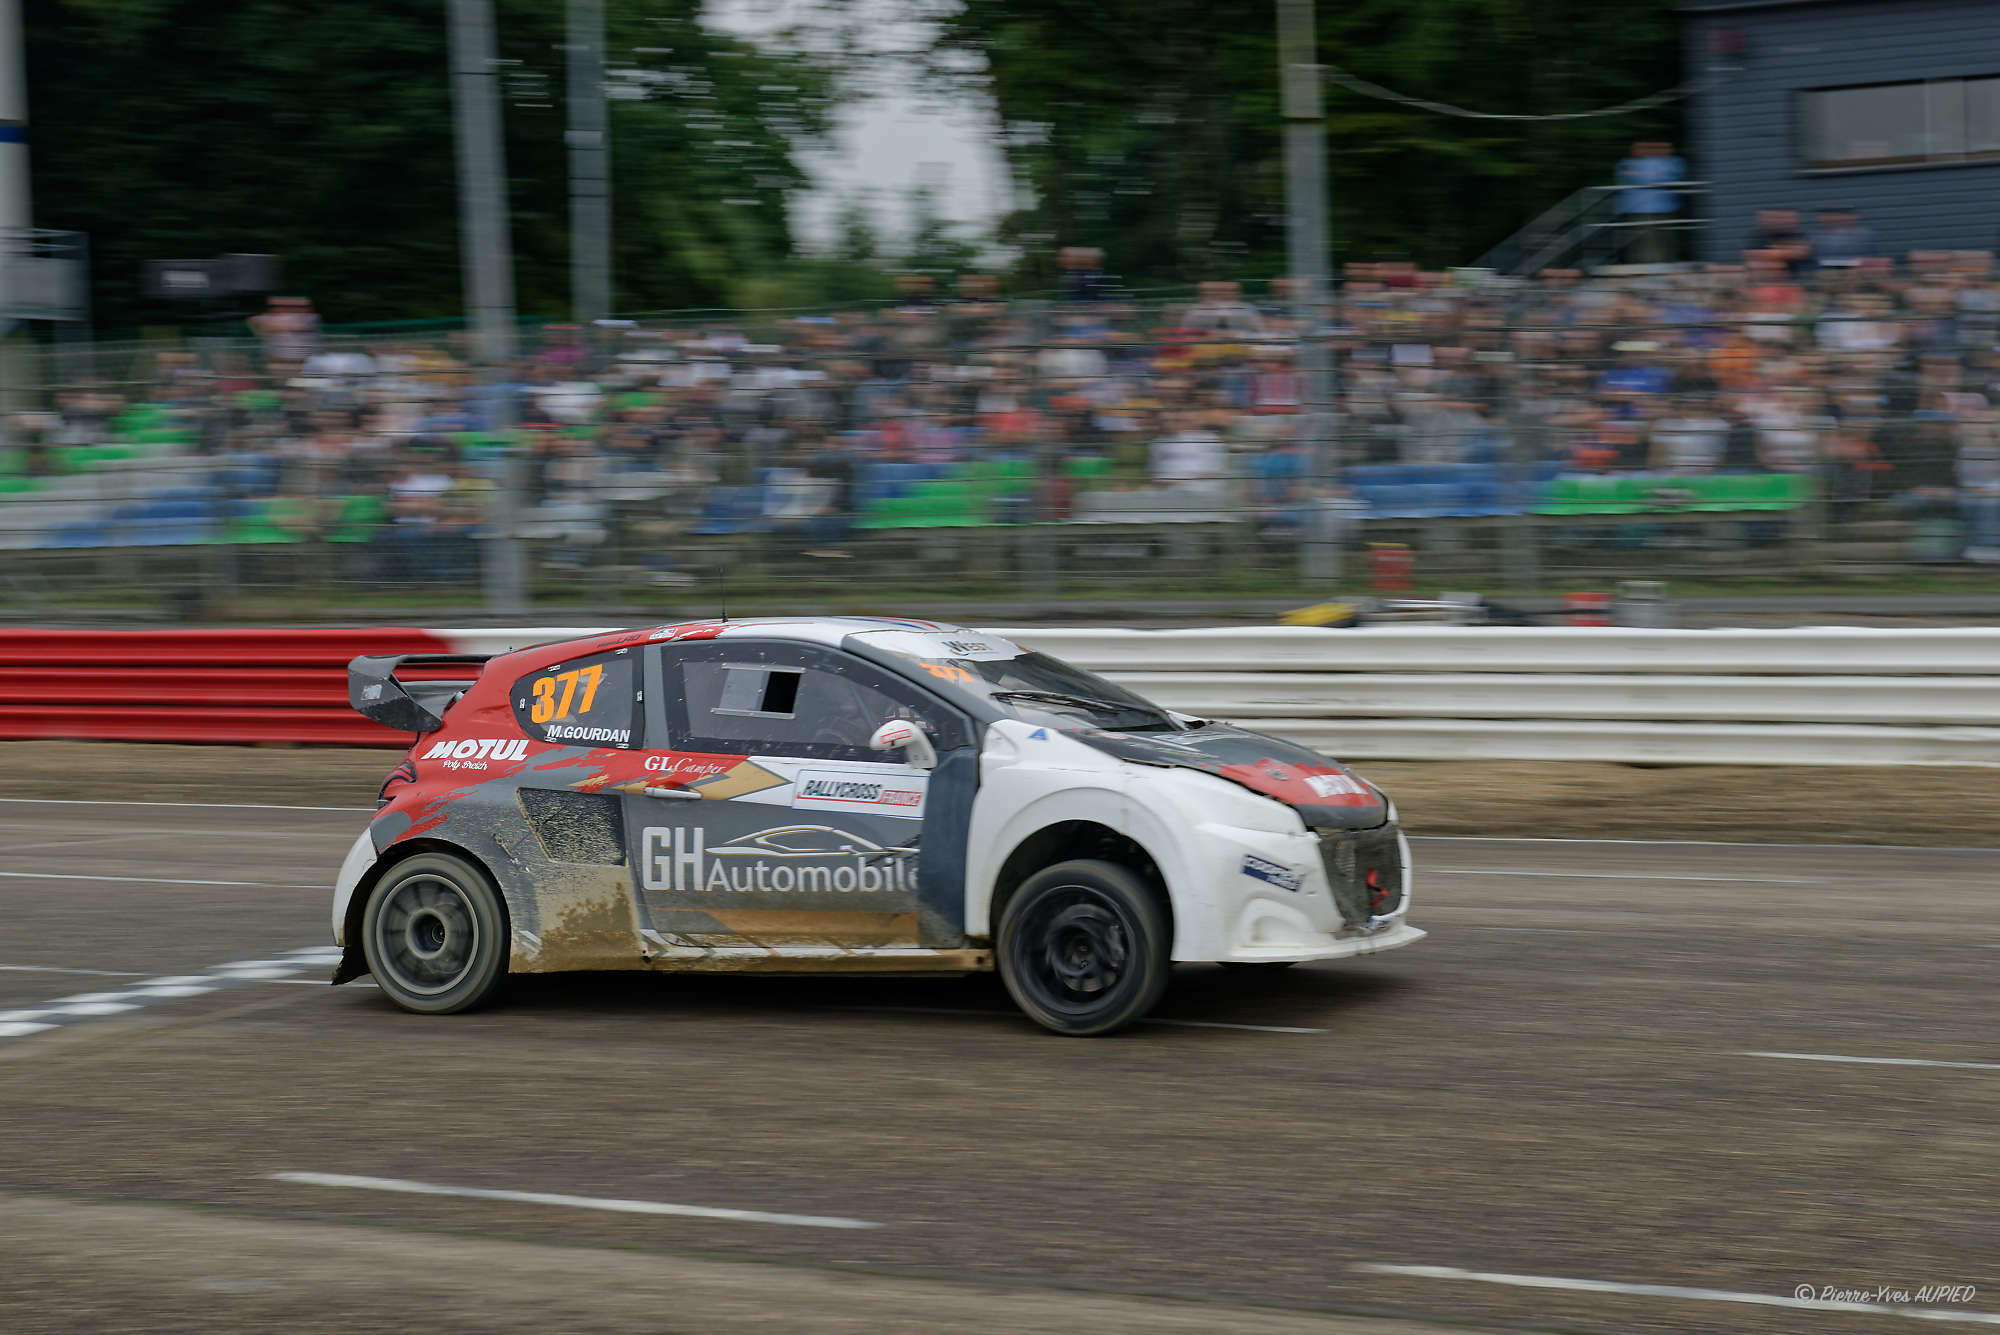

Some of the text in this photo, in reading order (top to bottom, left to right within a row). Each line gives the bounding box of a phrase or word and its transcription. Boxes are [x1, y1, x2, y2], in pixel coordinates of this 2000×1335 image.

[531, 664, 603, 724] 377
[546, 724, 631, 743] M.GOURDAN
[420, 739, 530, 761] MOTUL
[644, 755, 673, 771] GL
[803, 780, 882, 800] RALLYCROSS
[641, 826, 704, 891] GH
